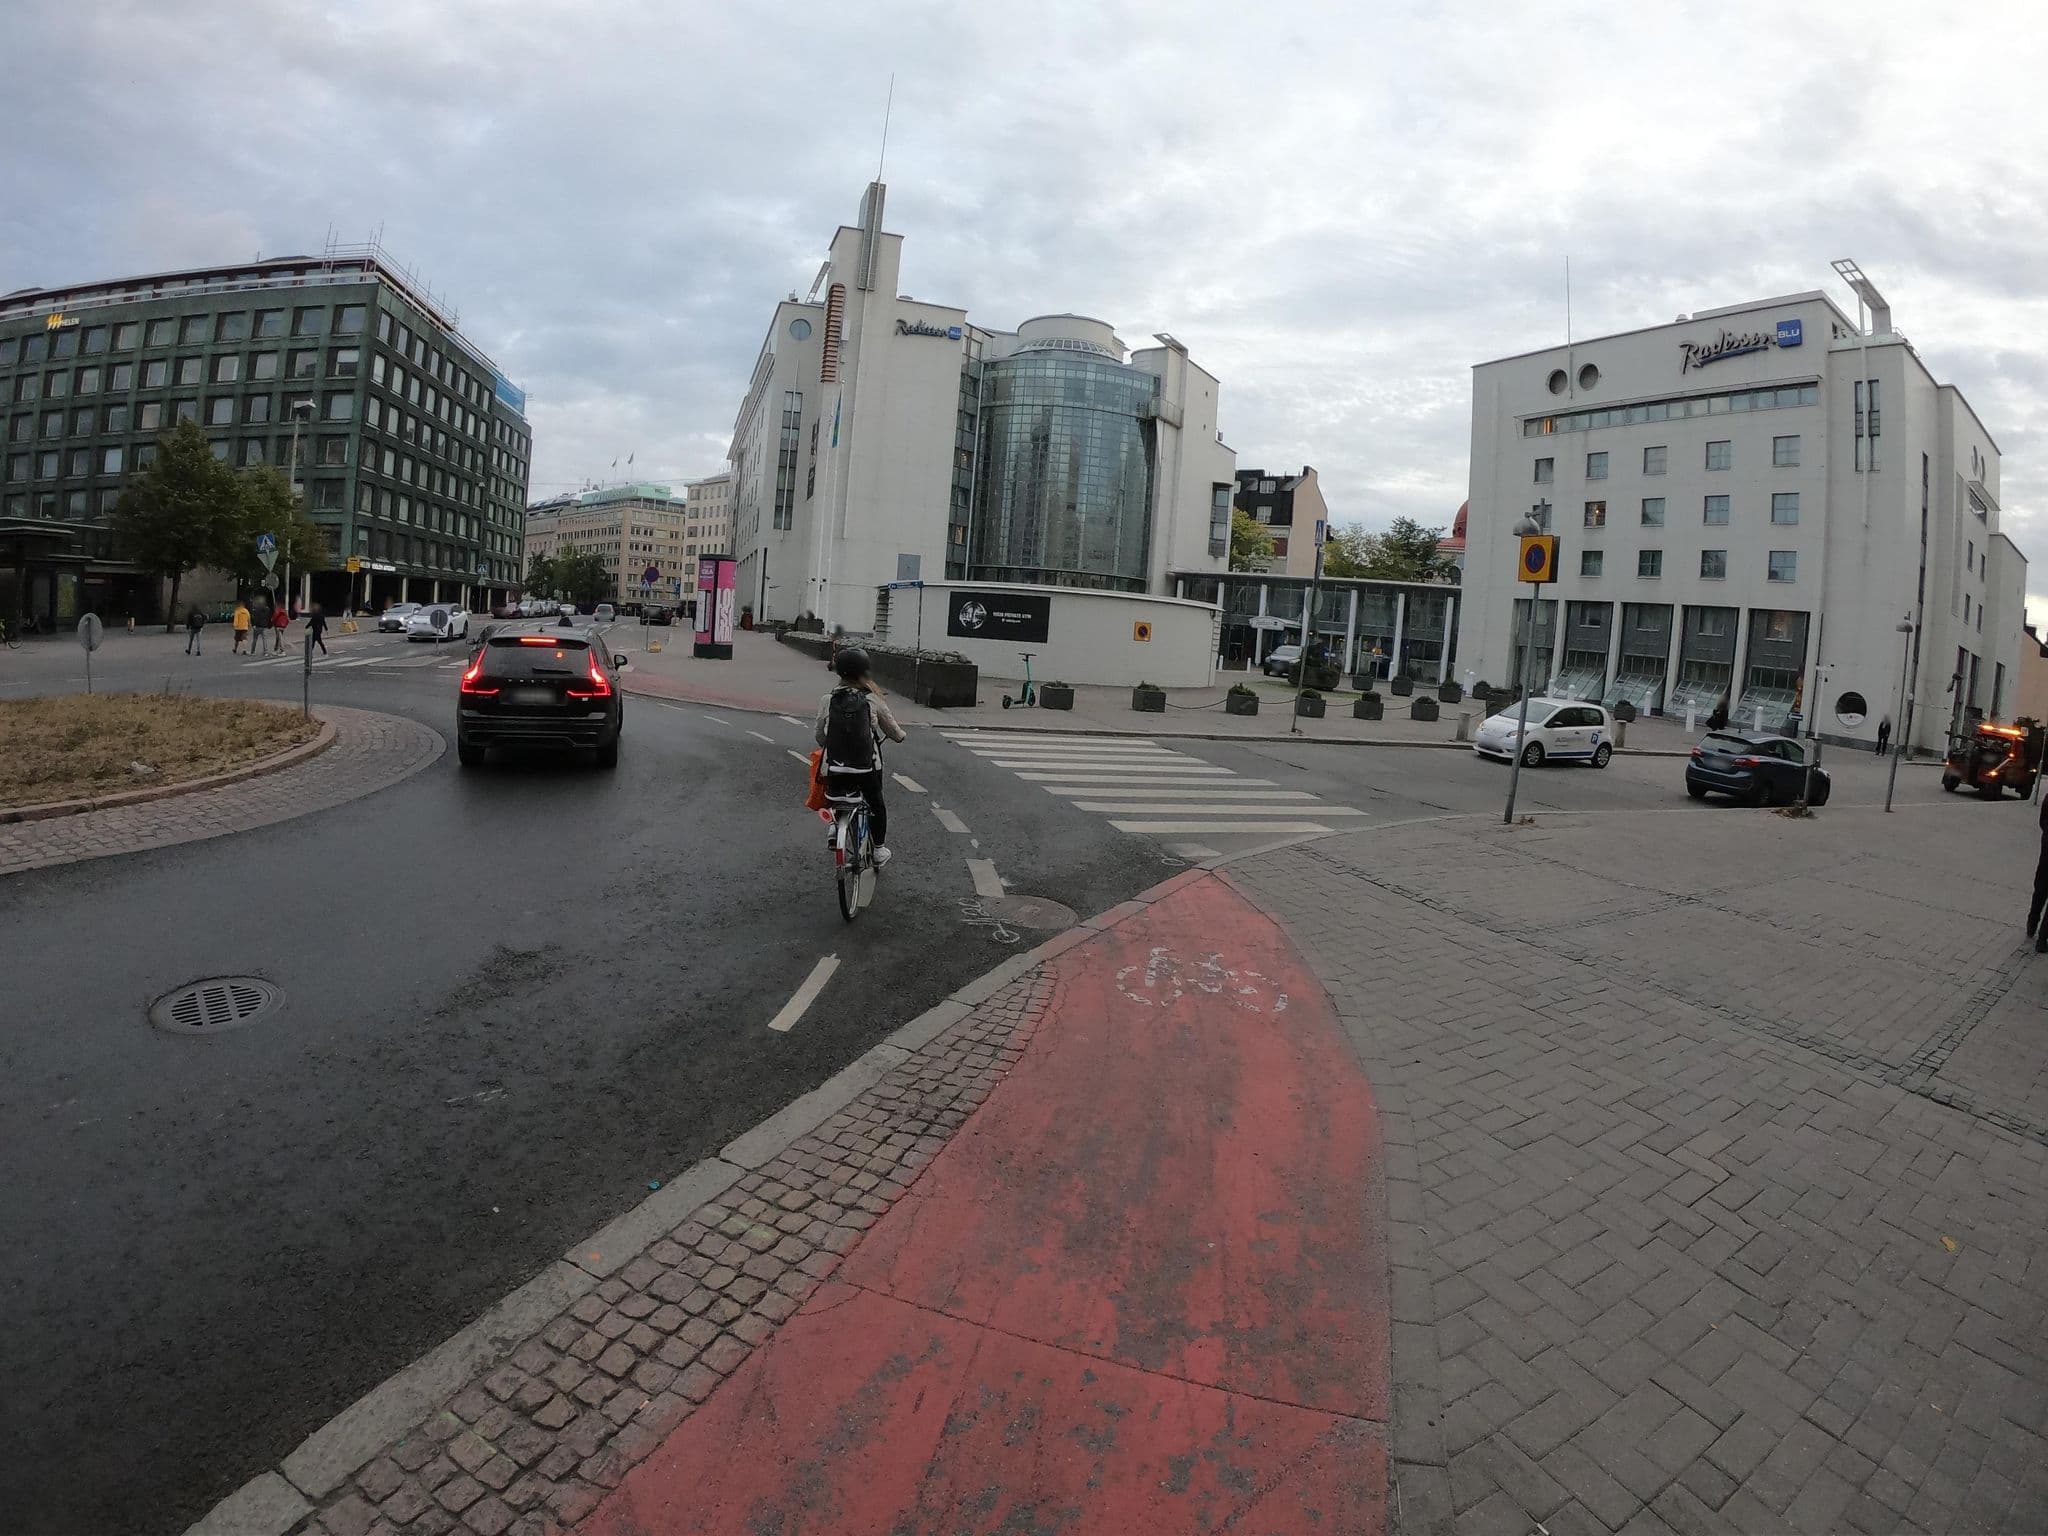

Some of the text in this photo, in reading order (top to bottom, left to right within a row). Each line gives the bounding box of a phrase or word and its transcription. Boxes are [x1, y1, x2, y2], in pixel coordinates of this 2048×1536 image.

[896, 318, 948, 338] Radisson
[1680, 327, 1800, 375] Radisson BLU
